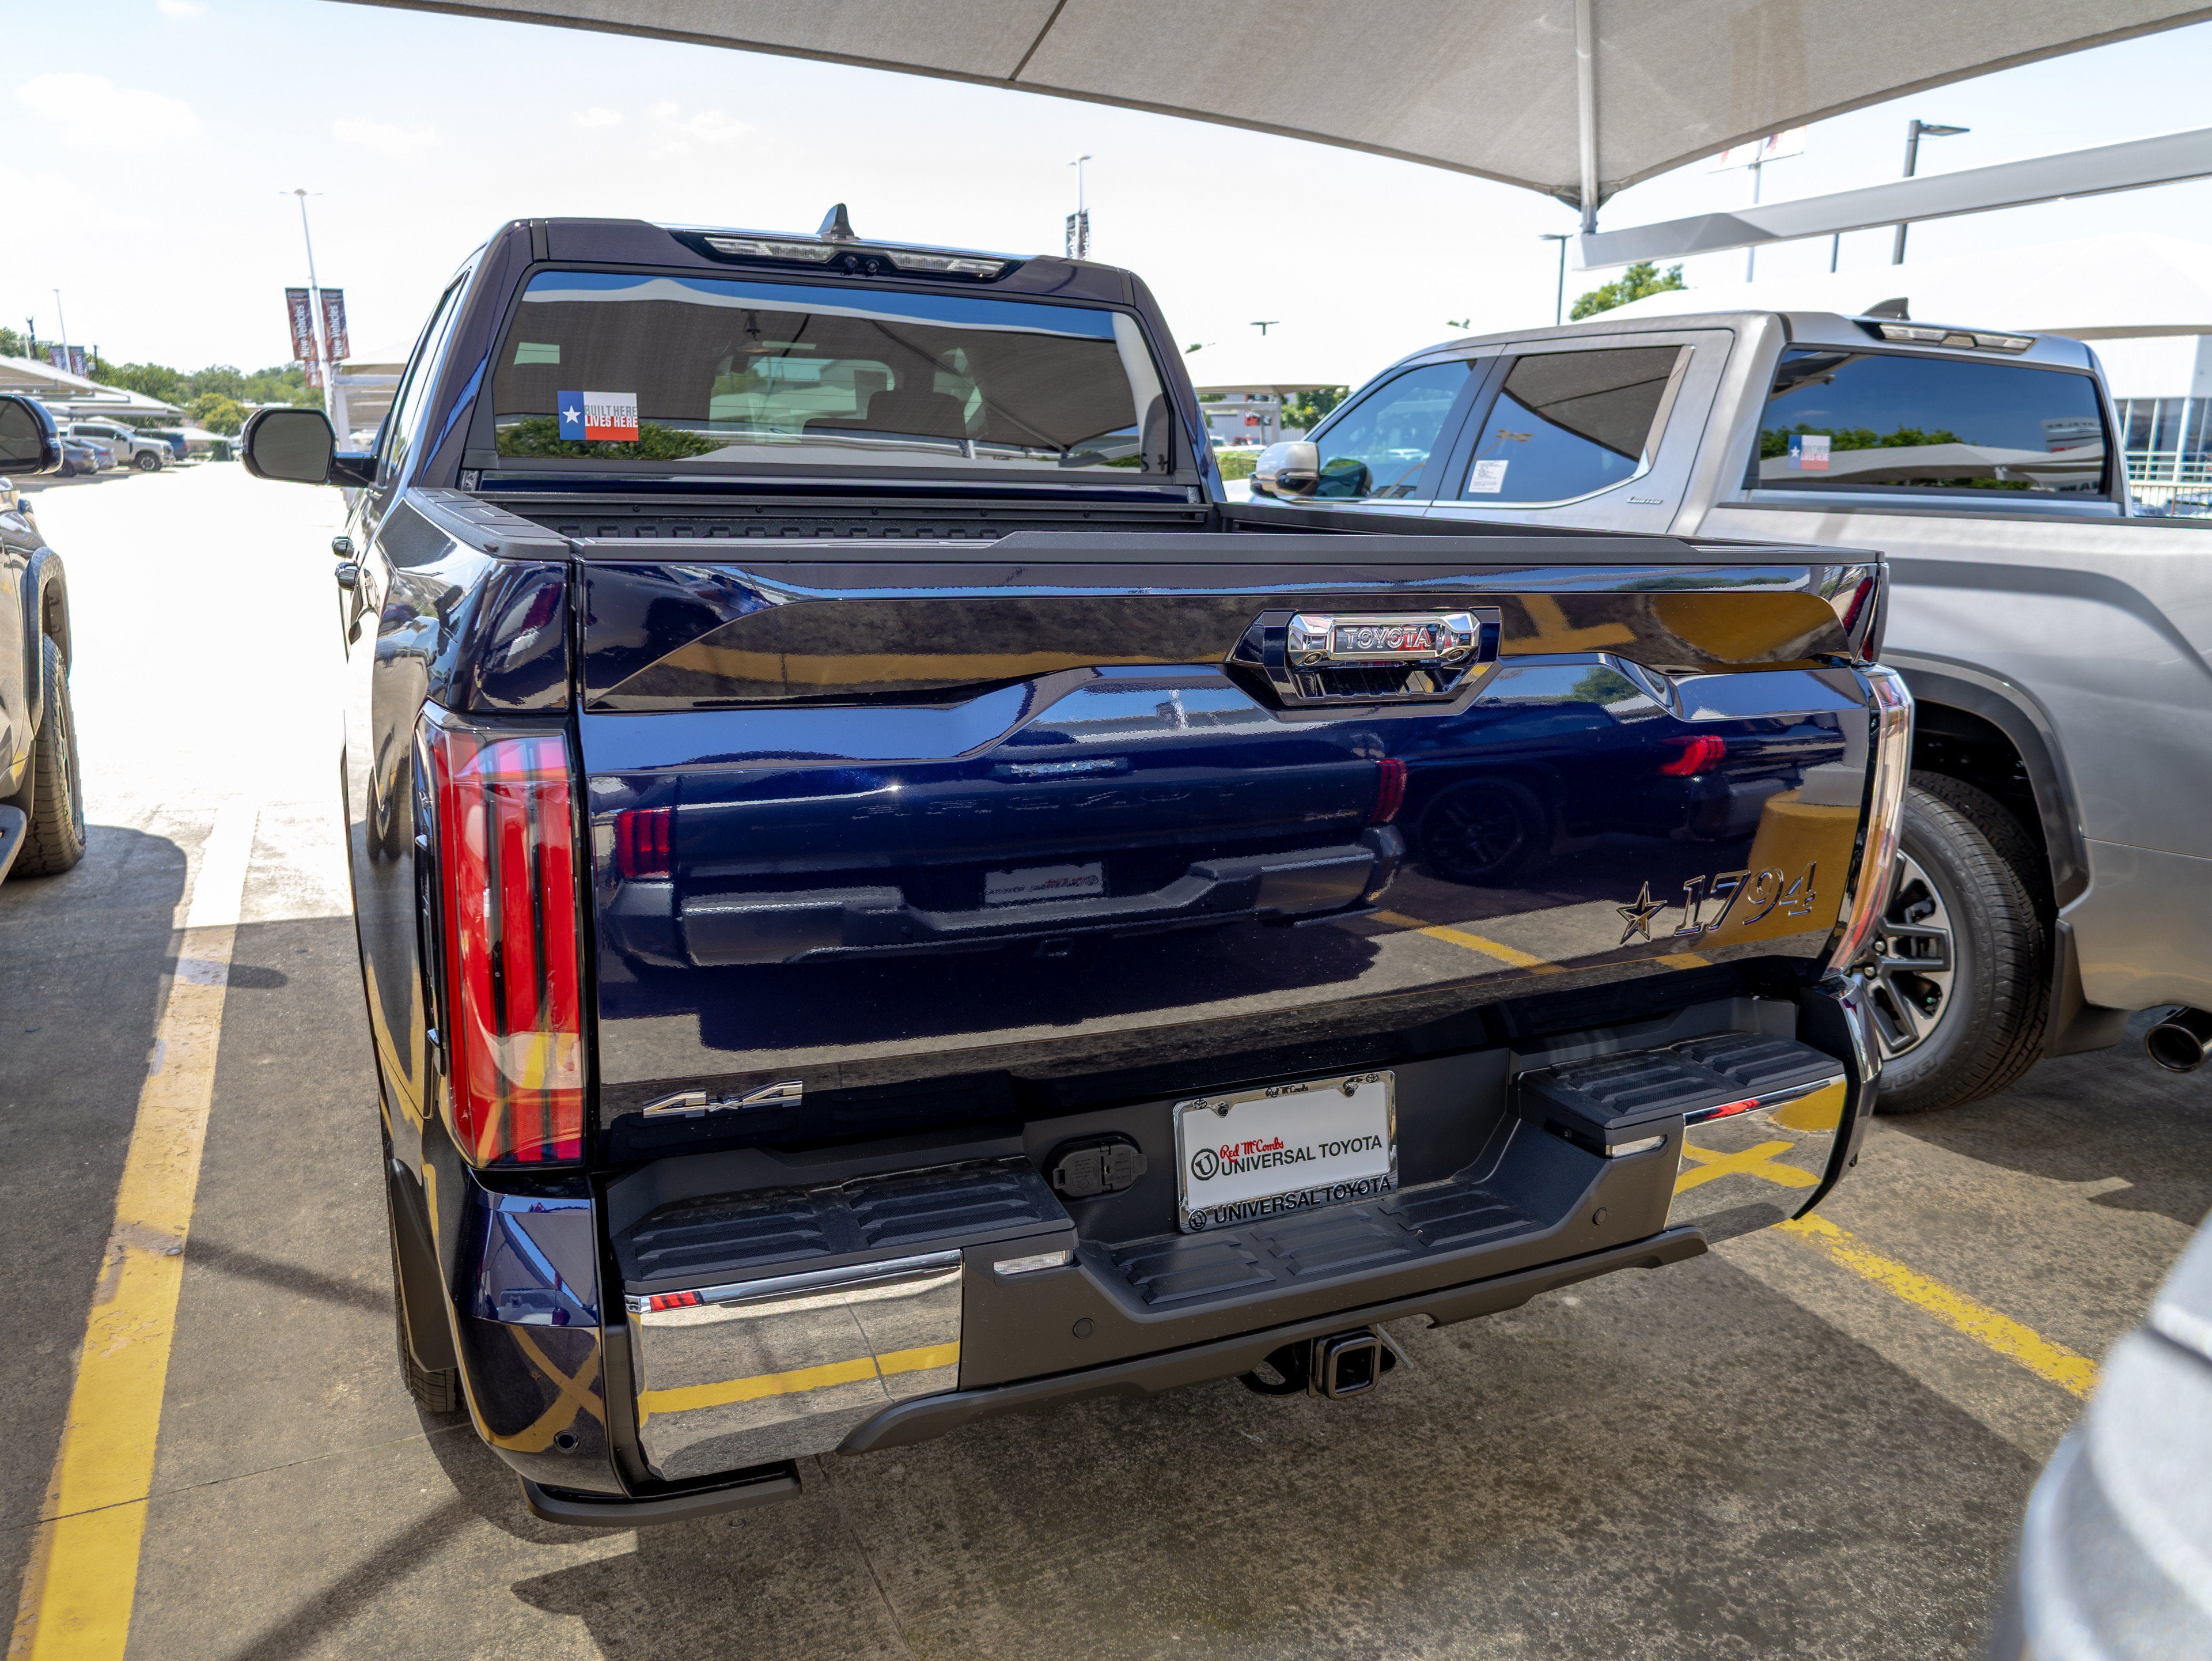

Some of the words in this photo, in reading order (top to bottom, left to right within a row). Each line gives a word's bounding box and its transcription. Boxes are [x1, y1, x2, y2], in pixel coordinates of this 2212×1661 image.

[294, 304, 309, 339] Vehicles
[328, 304, 342, 339] Vehicles
[299, 339, 312, 357] New
[332, 339, 344, 357] New
[584, 404, 611, 416] BUILT
[613, 406, 638, 417] HERE
[585, 415, 612, 427] LIVES
[613, 416, 638, 427] HERE
[1343, 626, 1432, 649] TOYOTA
[1674, 861, 1817, 936] 1794
[1265, 1087, 1279, 1098] Red
[1279, 1083, 1309, 1094] McCombs
[1219, 1144, 1240, 1163] Red
[1240, 1136, 1284, 1155] McCombs
[1221, 1145, 1316, 1176] UNIVERSAL
[1319, 1134, 1382, 1158] TOYOTA
[1213, 1191, 1321, 1224] UNIVERSAL
[1323, 1176, 1392, 1200] TOYOTA
